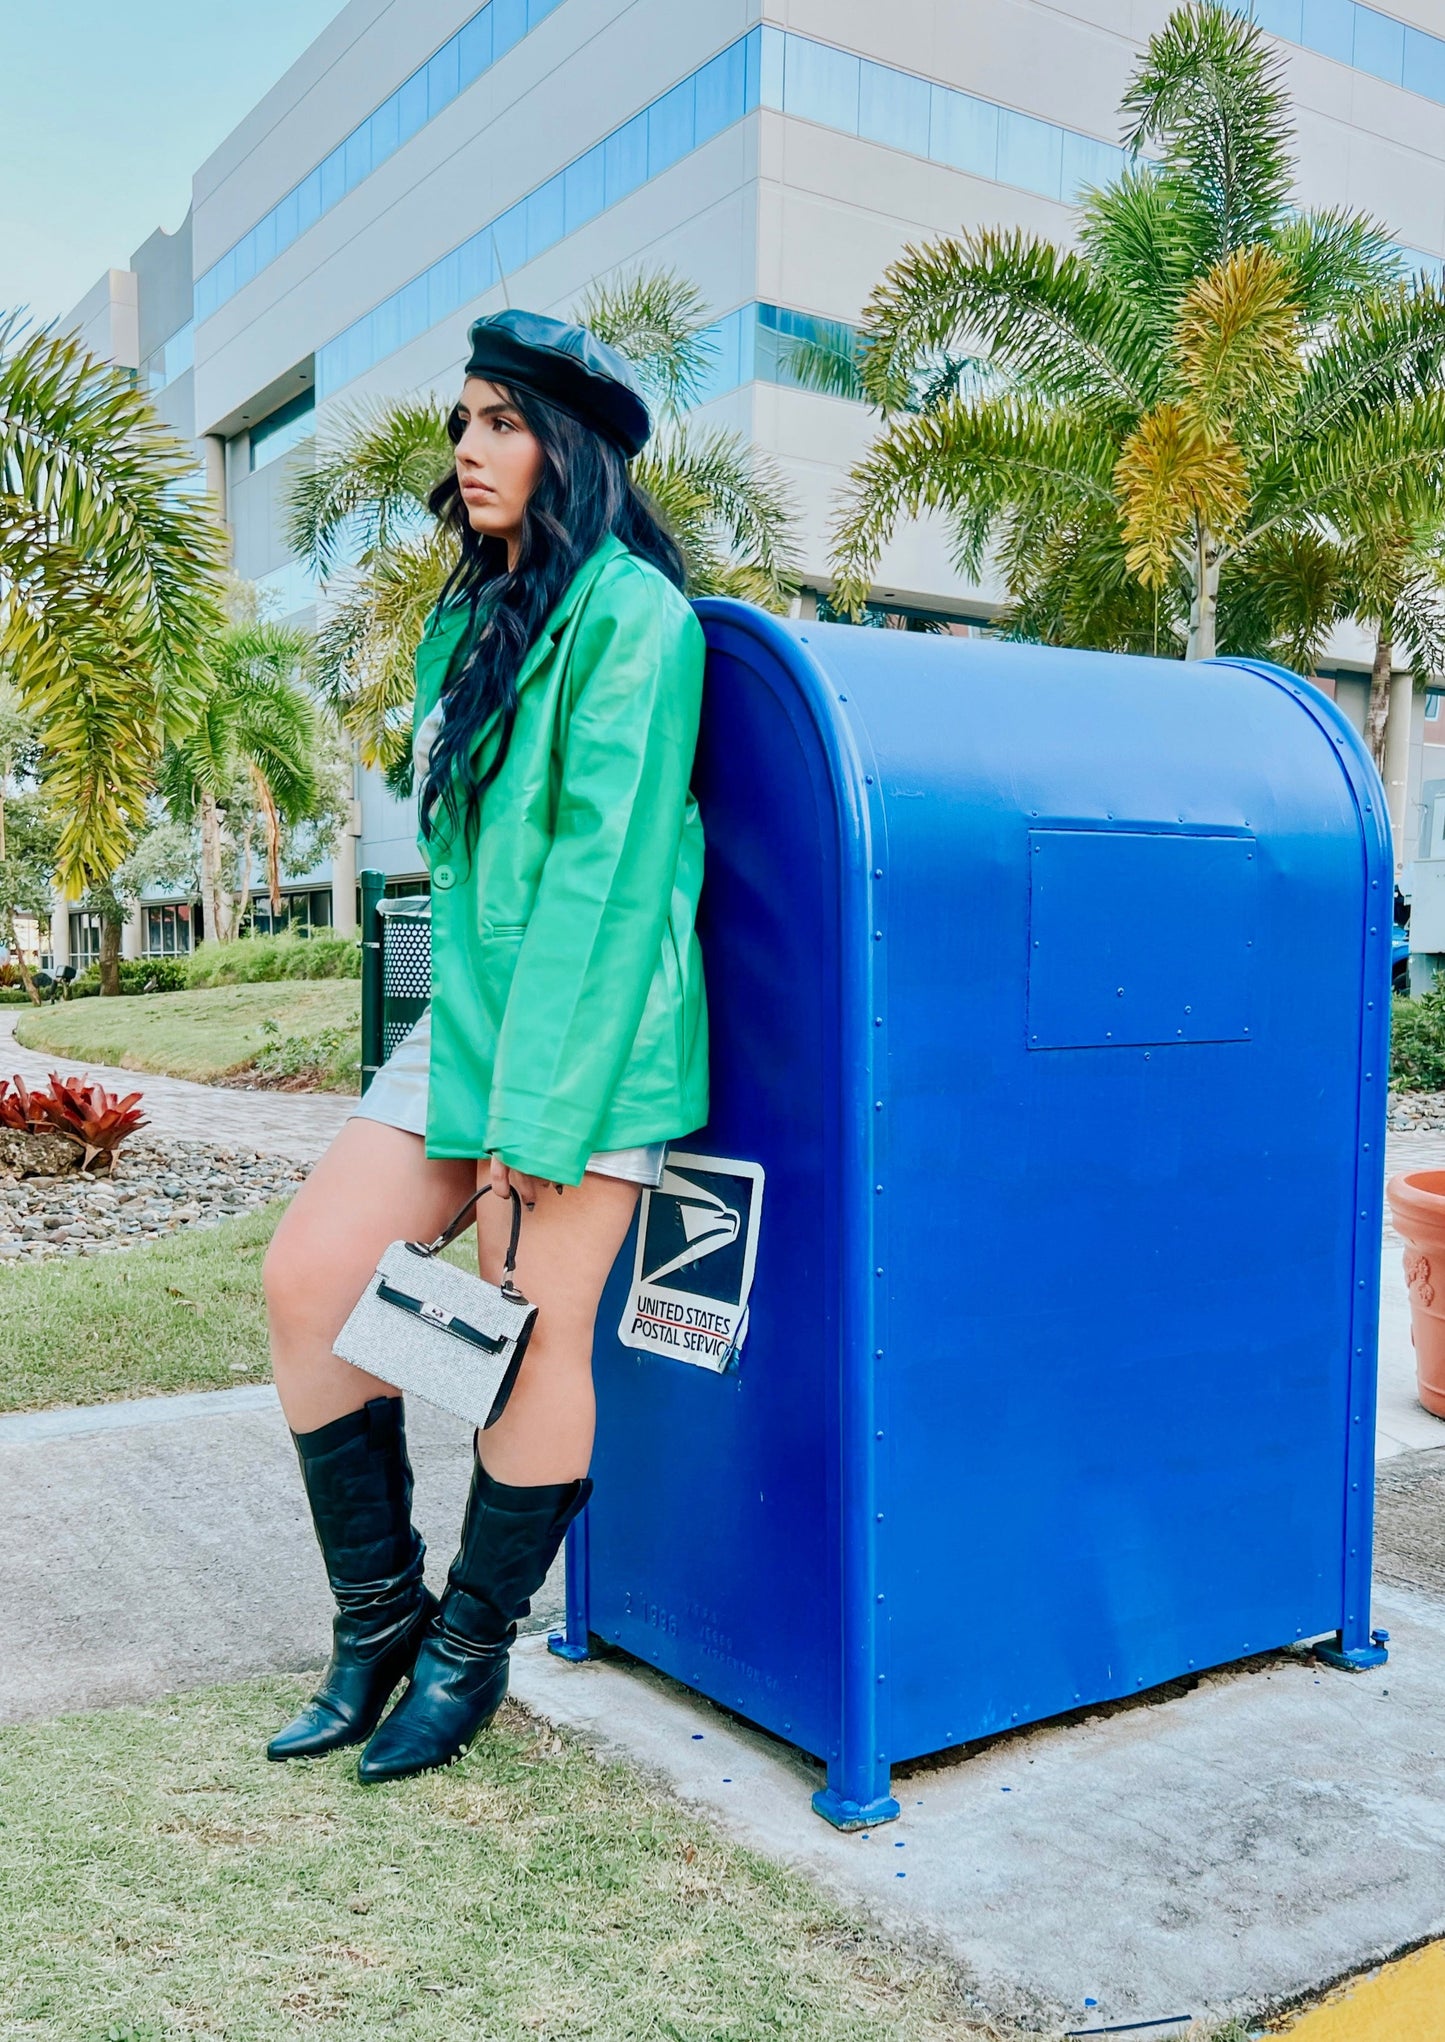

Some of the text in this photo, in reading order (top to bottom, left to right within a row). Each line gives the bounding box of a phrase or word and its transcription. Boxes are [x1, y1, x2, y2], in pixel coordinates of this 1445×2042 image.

[636, 1295, 731, 1335] UNITED STATES
[631, 1318, 727, 1356] POSTAL SERVIC
